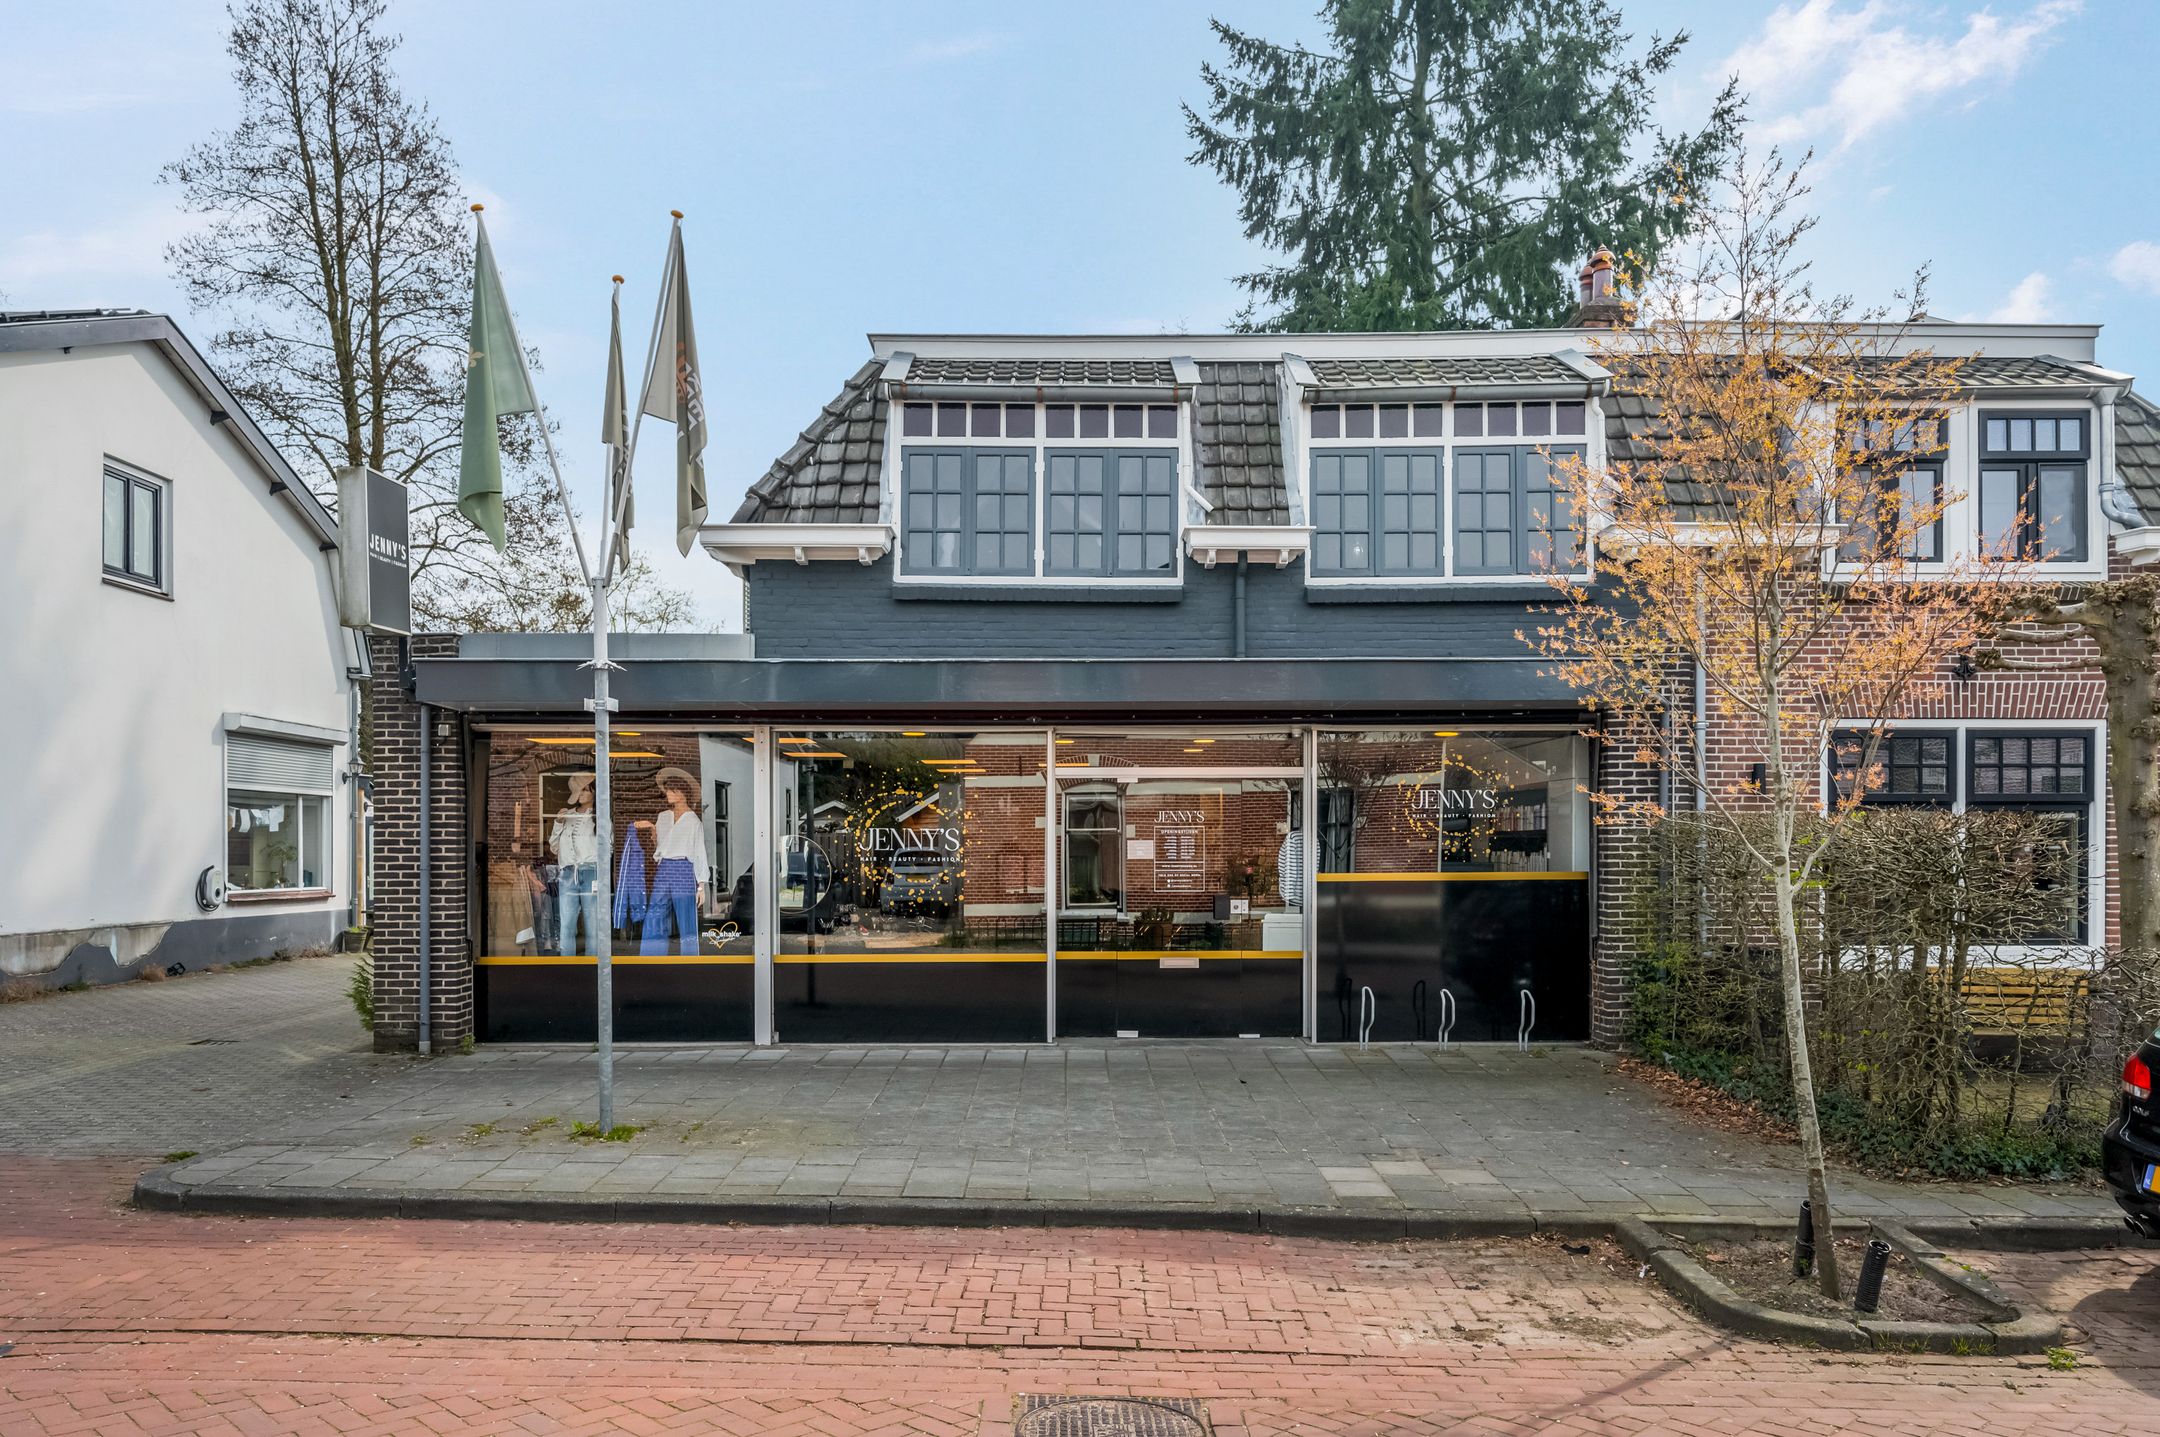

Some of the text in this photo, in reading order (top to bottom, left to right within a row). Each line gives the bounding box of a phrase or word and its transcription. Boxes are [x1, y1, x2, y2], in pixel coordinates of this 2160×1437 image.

[369, 533, 407, 560] JENNY'S
[1411, 789, 1495, 809] JENNY'S
[1154, 810, 1205, 823] JENNY'S
[859, 827, 961, 851] JENNY'S
